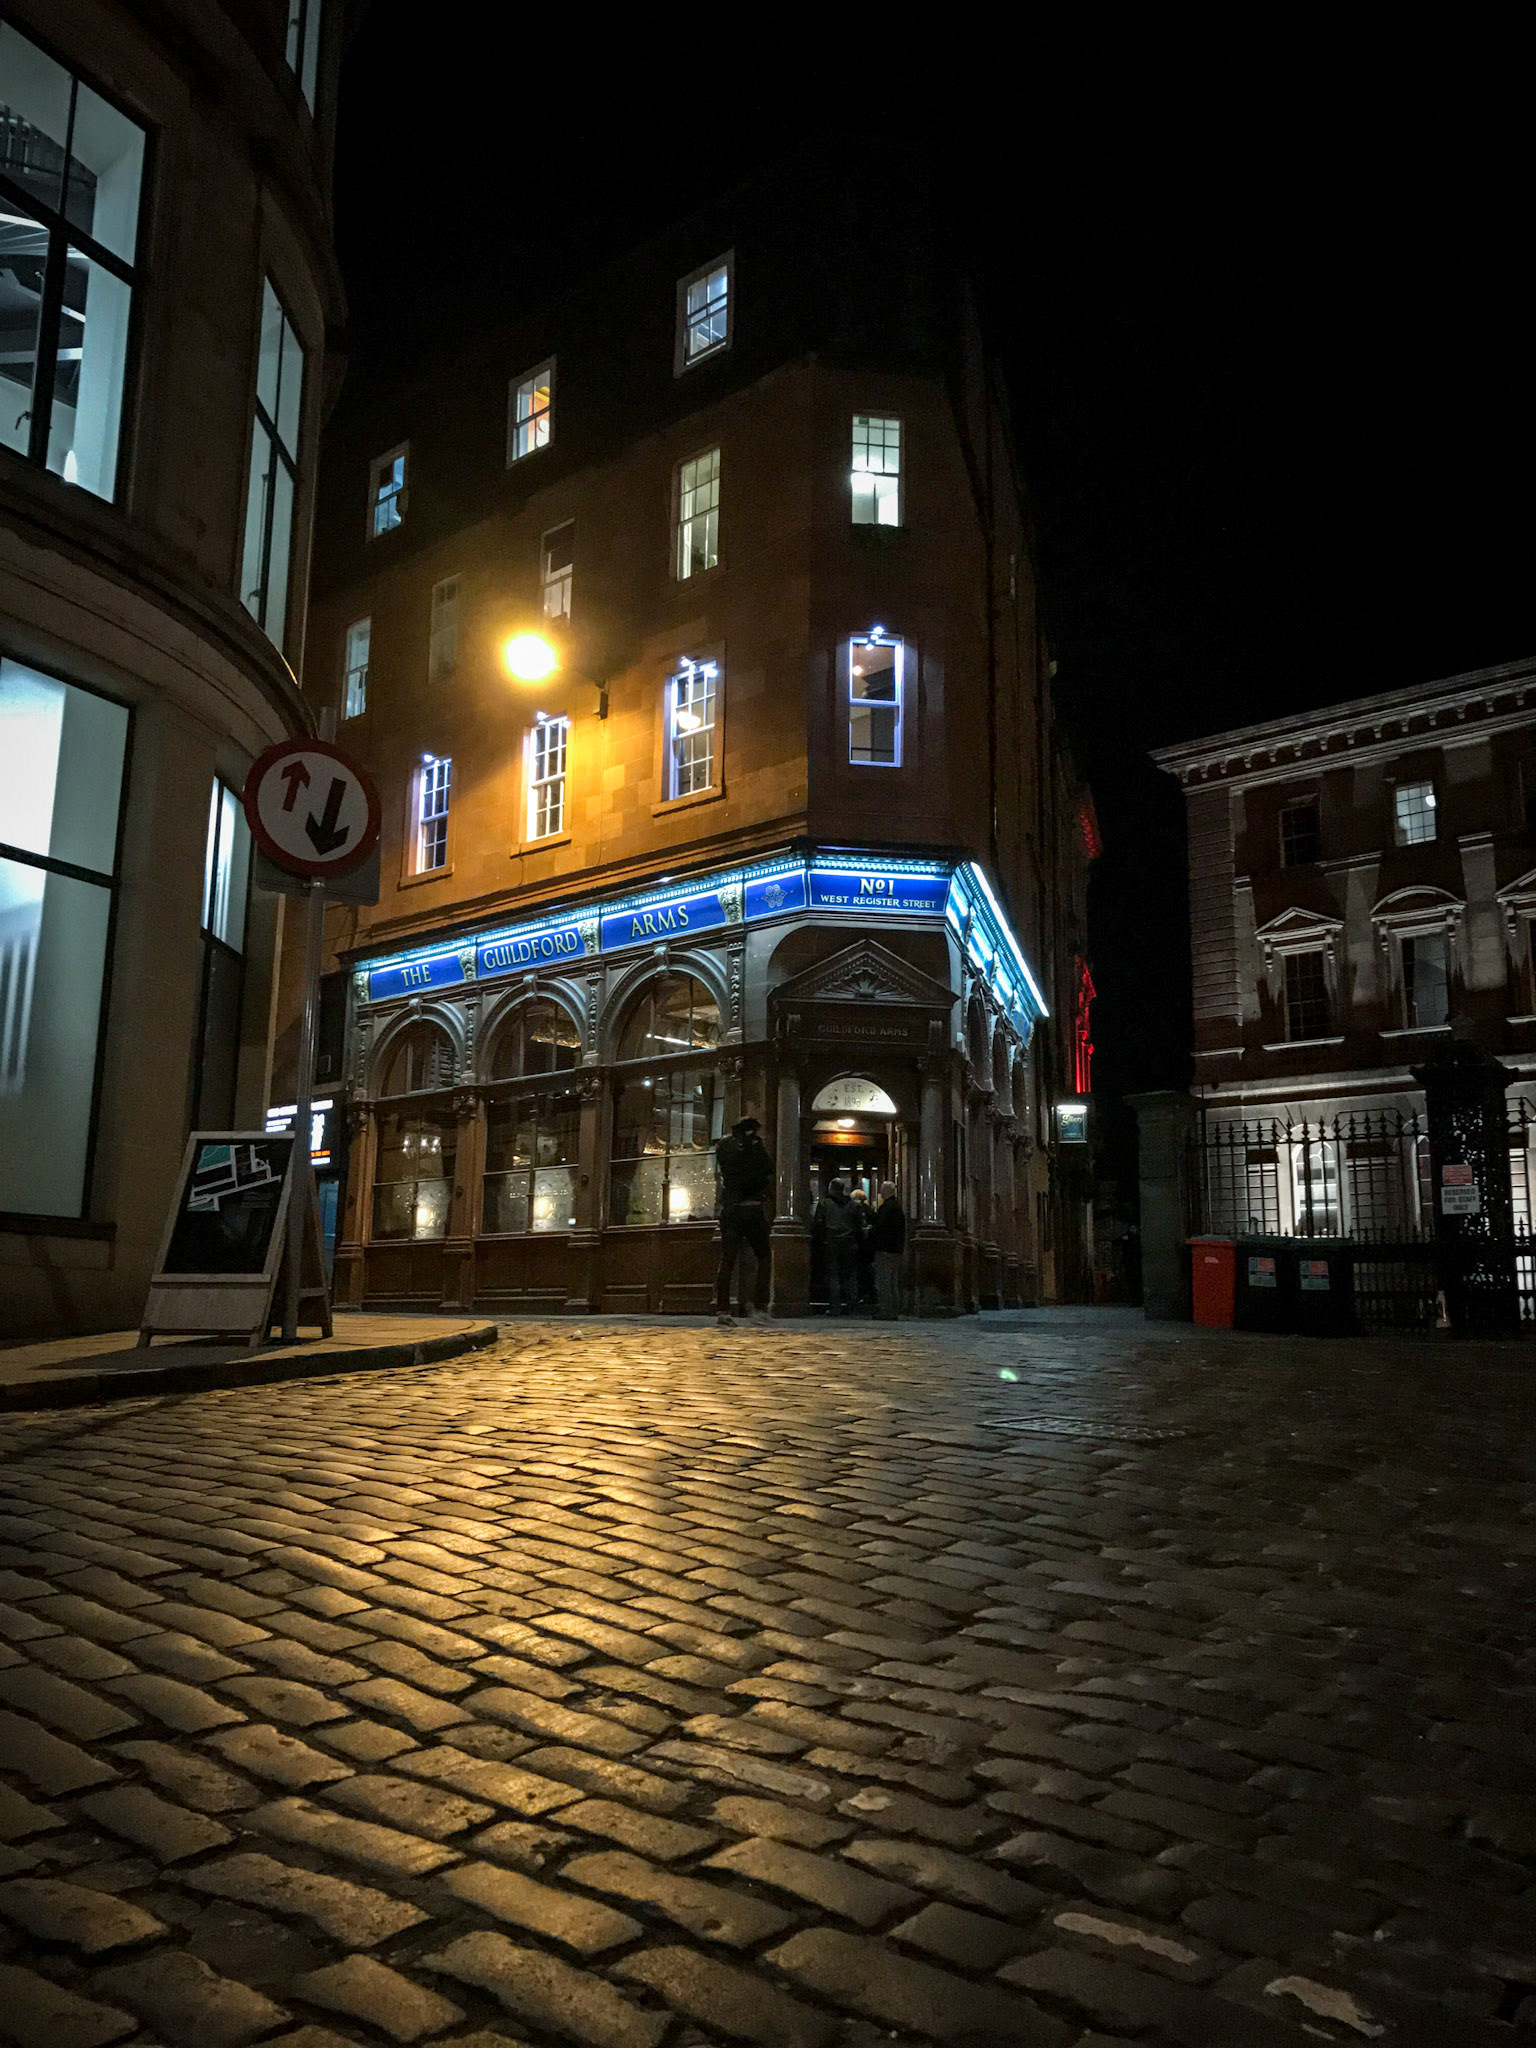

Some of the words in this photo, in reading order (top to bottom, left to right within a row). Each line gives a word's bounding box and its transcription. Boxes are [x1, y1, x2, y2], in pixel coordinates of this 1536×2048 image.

[820, 894, 850, 904] WEST
[853, 896, 900, 907] REGISTER
[902, 899, 937, 908] STREET
[401, 963, 432, 987] THE
[483, 931, 579, 970] GUILDFORD
[631, 904, 690, 938] ARMS
[818, 1024, 877, 1036] GUILDFORD
[879, 1027, 909, 1037] ARMS
